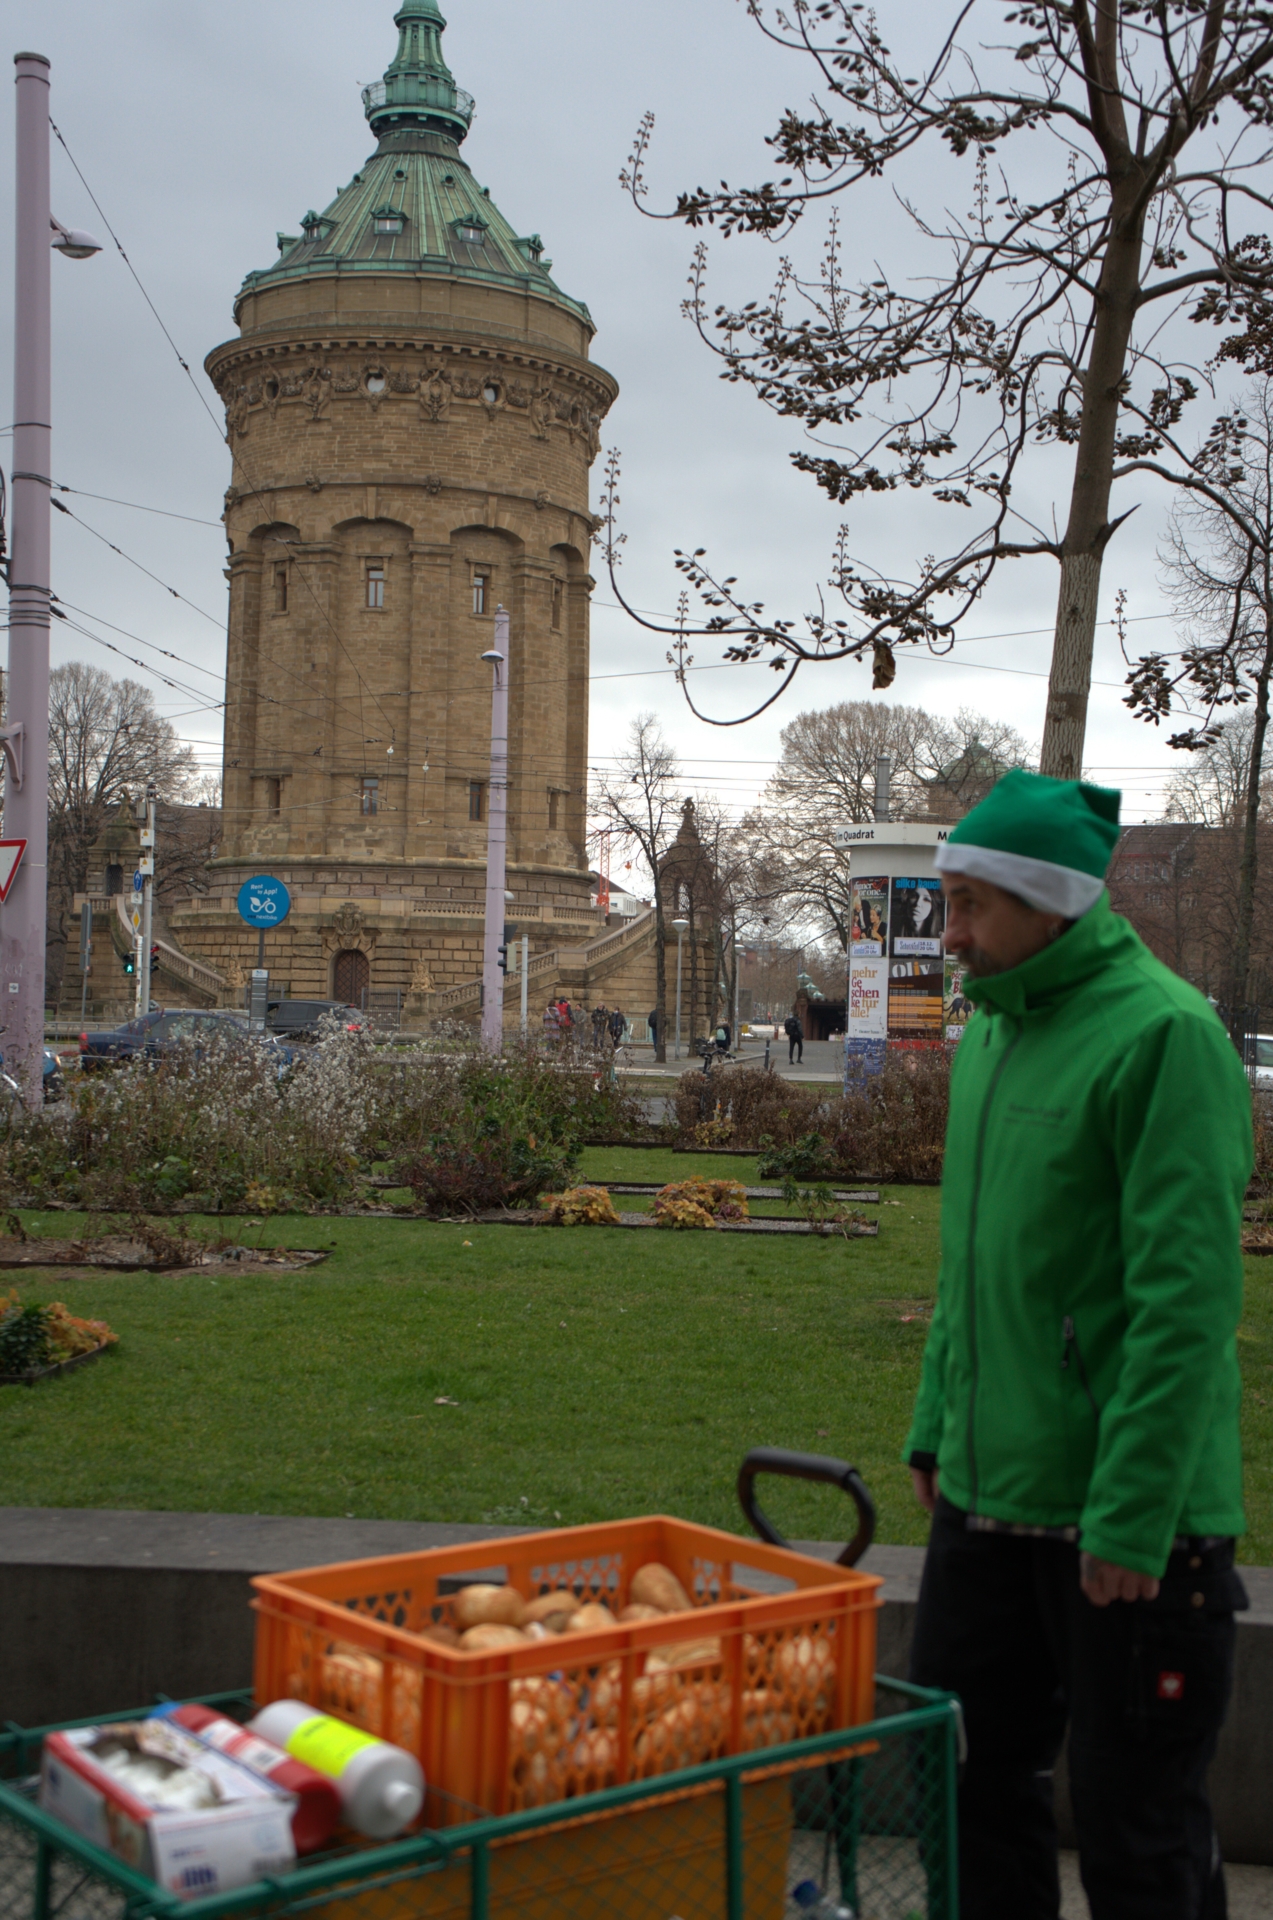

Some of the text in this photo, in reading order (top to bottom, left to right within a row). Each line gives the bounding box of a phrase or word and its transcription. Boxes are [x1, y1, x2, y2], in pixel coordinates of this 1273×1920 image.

[843, 830, 875, 842] Quadrat
[895, 878, 916, 889] silke
[263, 888, 278, 896] App!
[852, 966, 878, 978] mehr
[851, 977, 862, 988] Ge
[851, 987, 880, 998] schen
[851, 997, 860, 1007] ke
[850, 1006, 869, 1018] alle!
